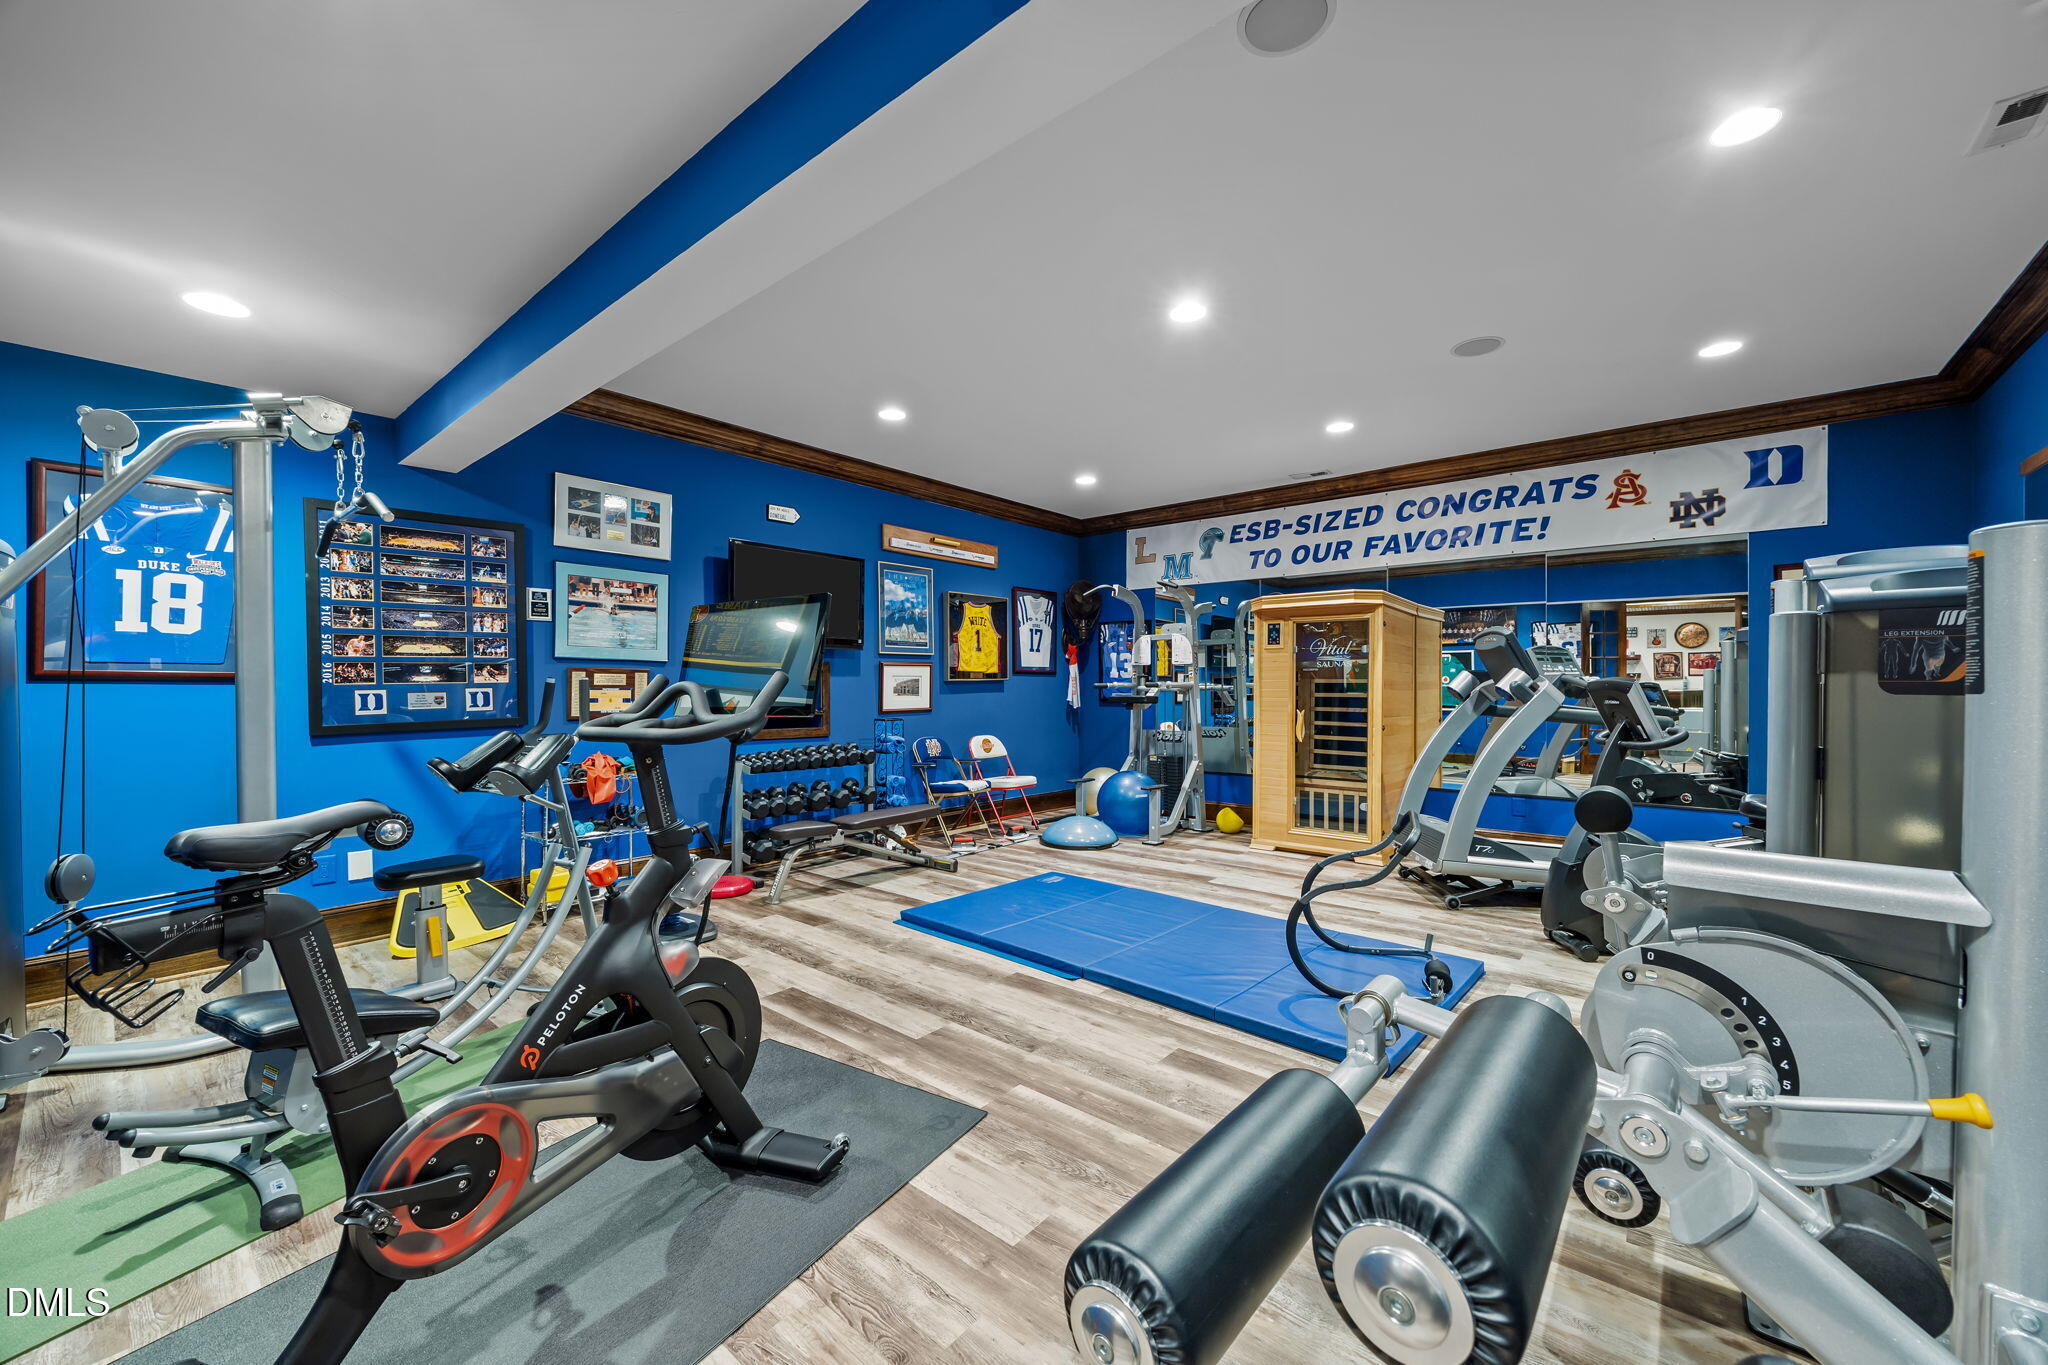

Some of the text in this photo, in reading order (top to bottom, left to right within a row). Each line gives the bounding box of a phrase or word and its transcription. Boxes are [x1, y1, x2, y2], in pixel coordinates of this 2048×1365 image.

[1229, 473, 1600, 544] ESB-SIZED CONGRATS
[1135, 536, 1156, 564] L
[1250, 515, 1551, 569] TO OUR FAVORITE!
[138, 560, 180, 572] DUKE
[1161, 552, 1194, 580] M
[320, 577, 330, 598] 2013
[115, 568, 204, 635] 18
[321, 606, 331, 626] 2014
[968, 616, 987, 628] WHITE
[322, 634, 332, 655] 2015
[975, 630, 982, 652] 1
[1029, 628, 1043, 652] 17
[1310, 636, 1353, 656] Vital
[322, 662, 332, 684] 2016
[1110, 652, 1132, 678] 13
[1647, 952, 1654, 960] 0
[1741, 997, 1747, 1006] 1
[536, 983, 586, 1046] PELOTON
[1758, 1016, 1767, 1026] 2
[1772, 1037, 1781, 1047] 3
[1780, 1060, 1790, 1070] 4
[1782, 1080, 1791, 1090] 5
